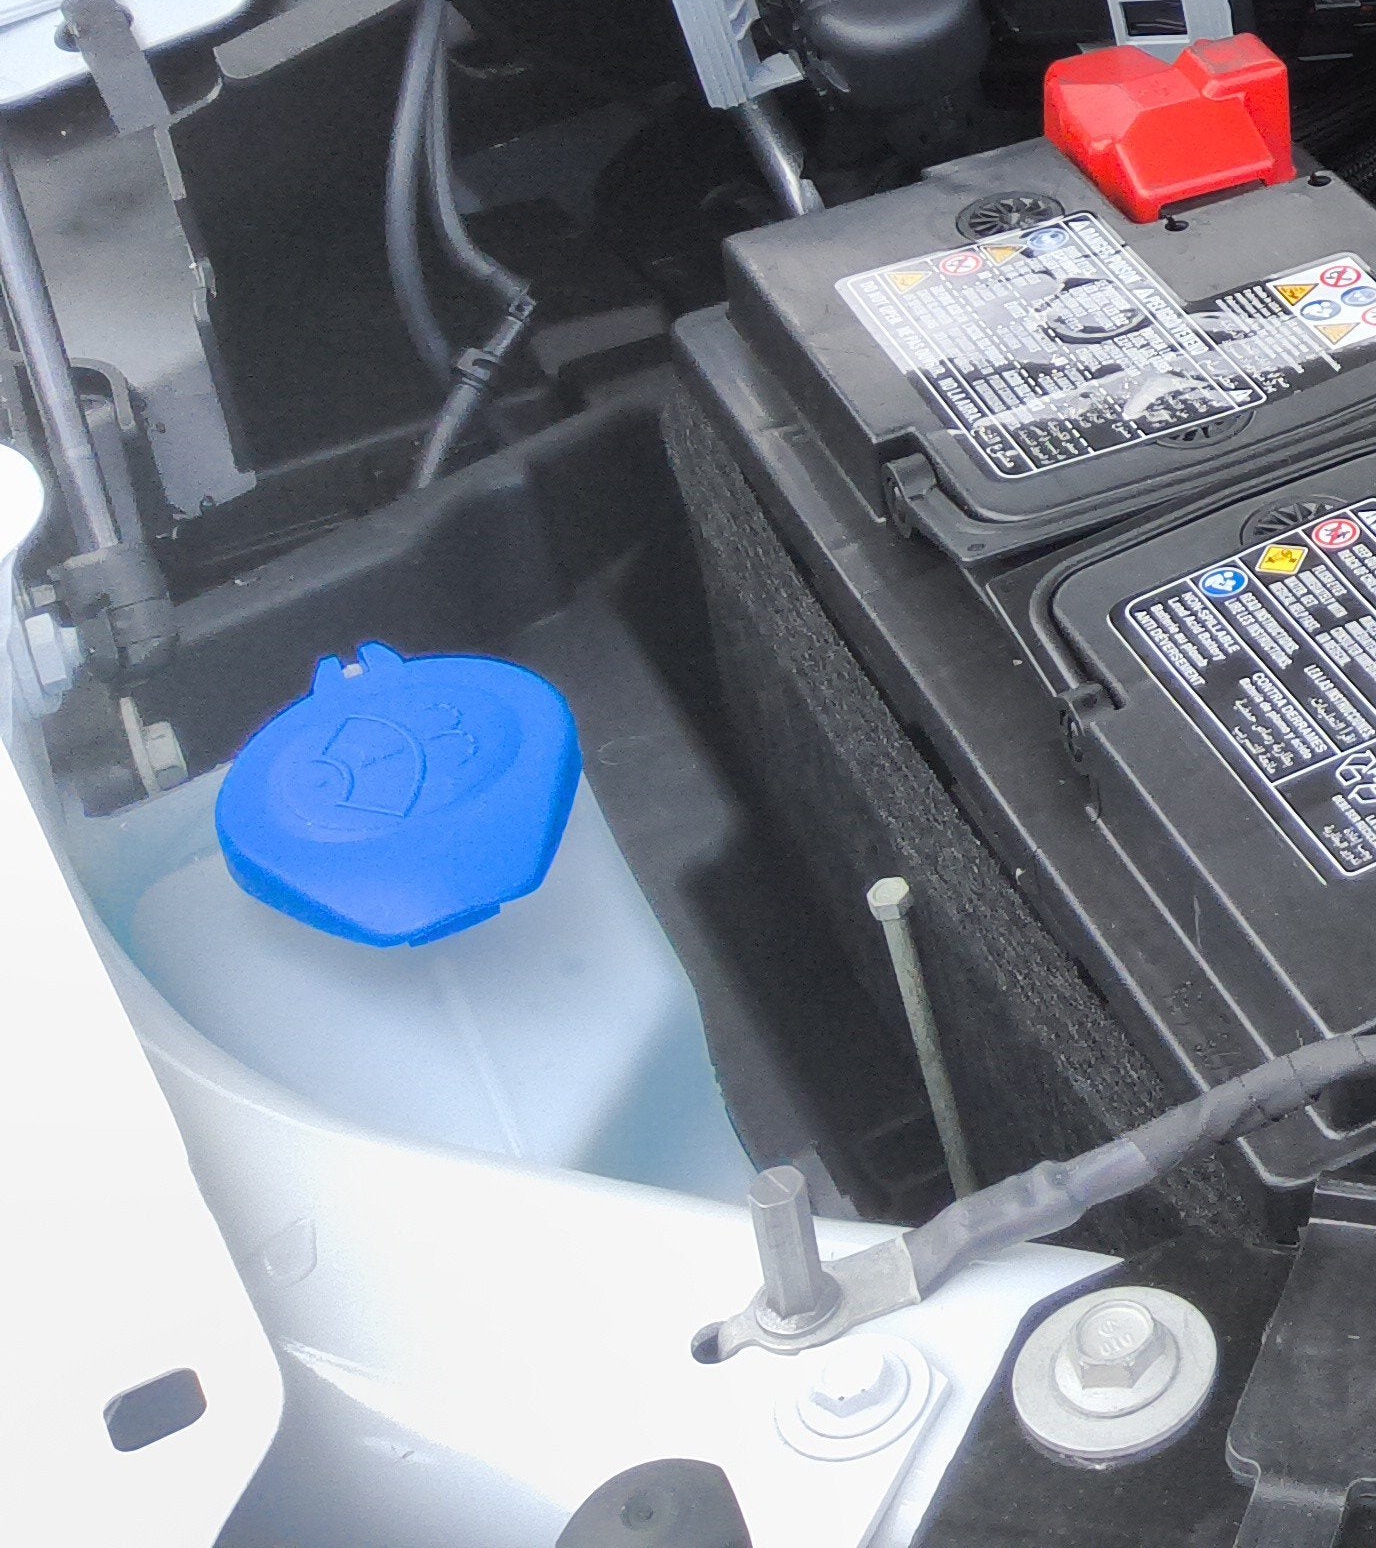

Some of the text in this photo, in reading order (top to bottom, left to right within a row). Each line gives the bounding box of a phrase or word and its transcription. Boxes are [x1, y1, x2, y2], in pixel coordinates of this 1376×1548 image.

[1133, 609, 1208, 688] ANTI DÉVERSEMENT
[1166, 596, 1229, 663] Lead Acid Battery
[1179, 590, 1241, 654] NON-SPILLABLE
[1234, 609, 1256, 626] LES
[1301, 663, 1324, 680] LEA
[1312, 674, 1335, 692] LAS
[1249, 670, 1329, 754] CONTRA DERRAMES
